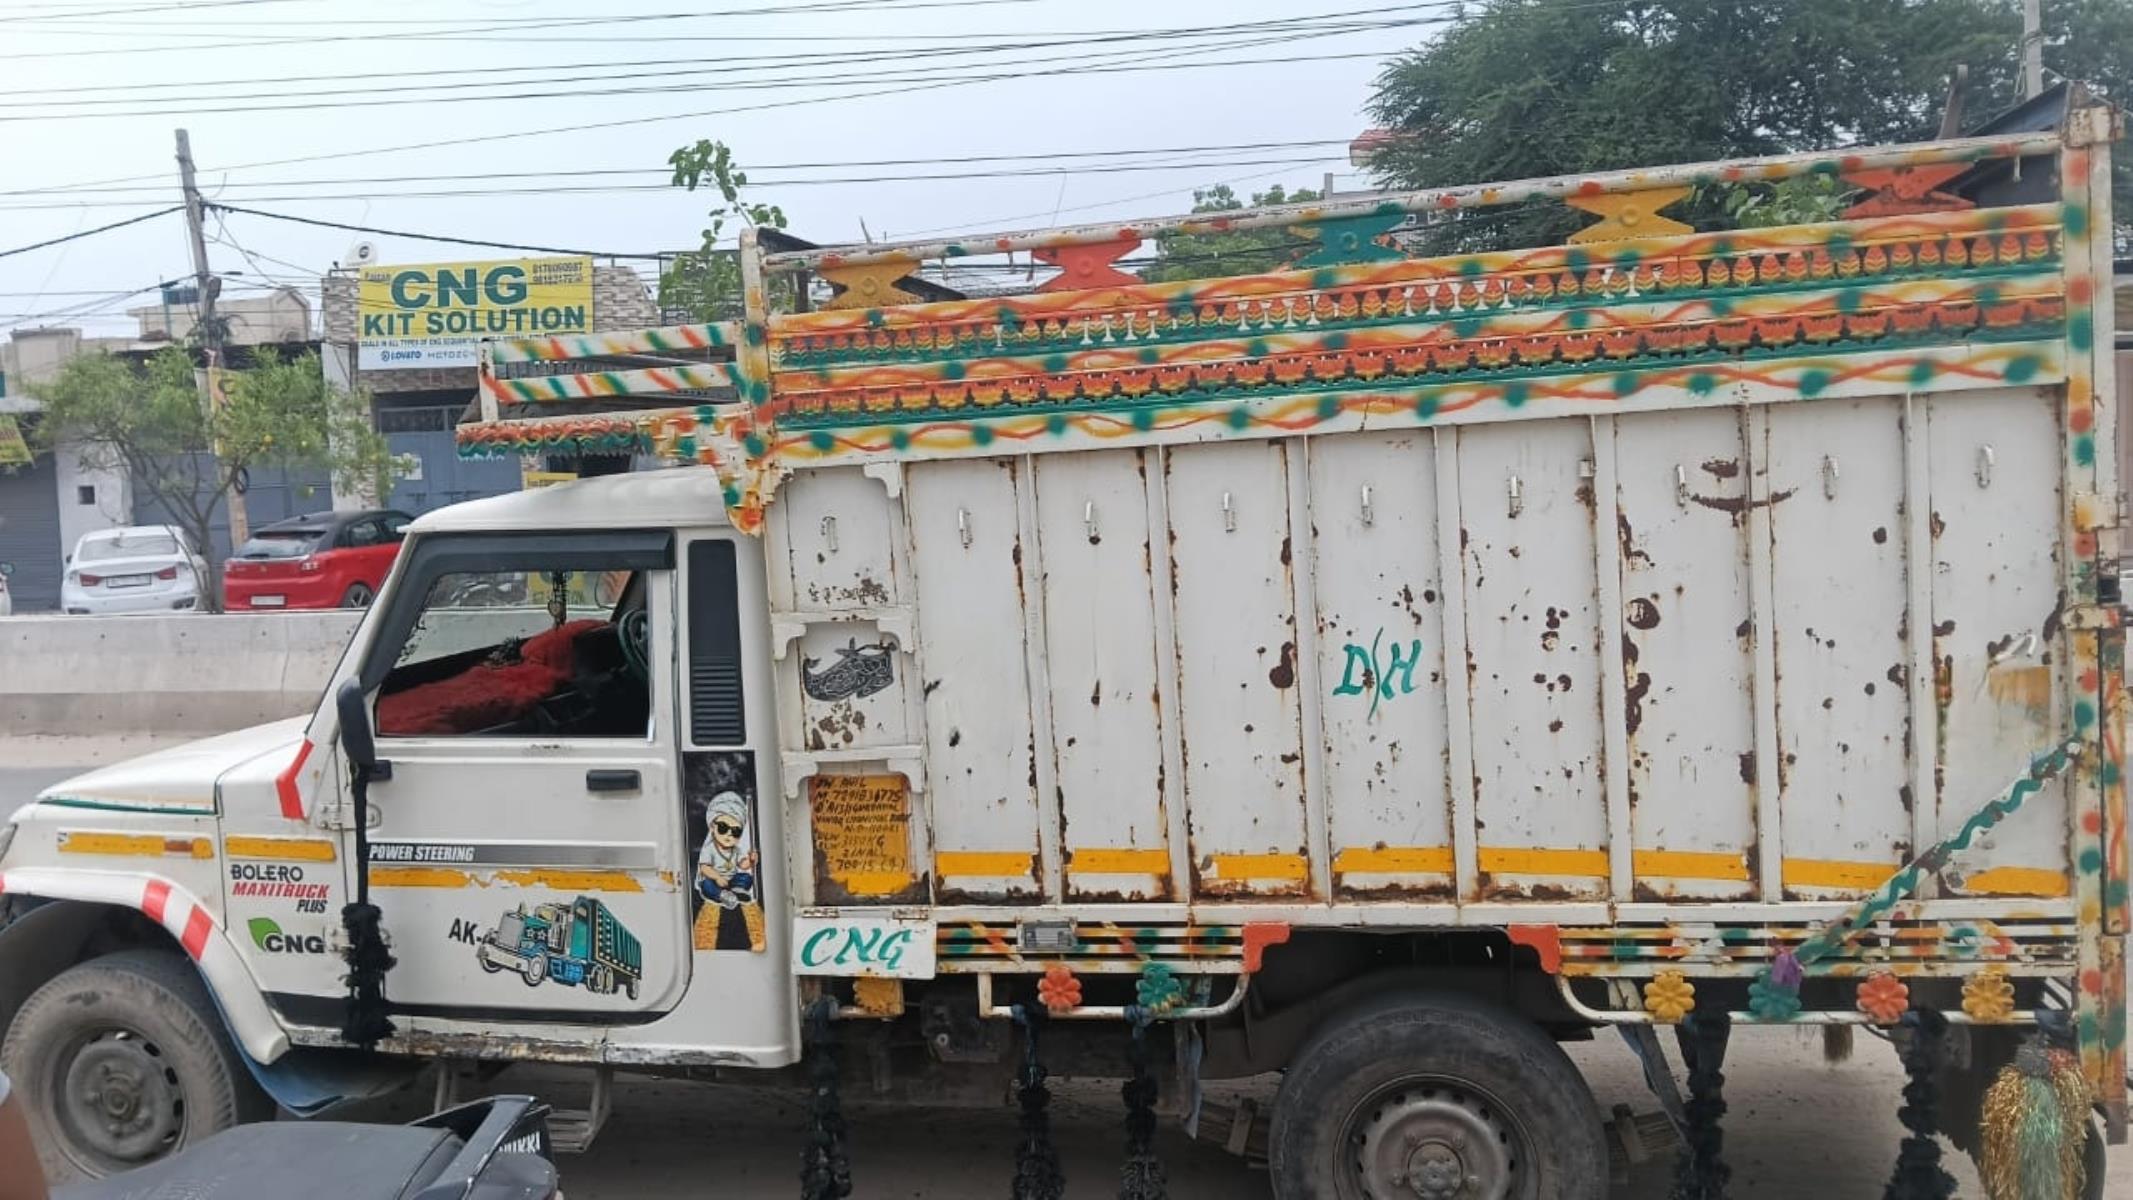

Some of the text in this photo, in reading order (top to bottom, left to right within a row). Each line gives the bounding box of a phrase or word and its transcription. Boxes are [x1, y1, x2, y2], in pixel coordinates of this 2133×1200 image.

[391, 266, 527, 308] CNG
[364, 305, 585, 336] KIT SOLUTION
[369, 844, 476, 862] POWER STEERING
[230, 864, 304, 882] BOLERO
[232, 882, 330, 898] MAXITRUCK
[296, 899, 329, 914] PLUS
[265, 934, 326, 954] CNG
[801, 926, 912, 970] CNG
